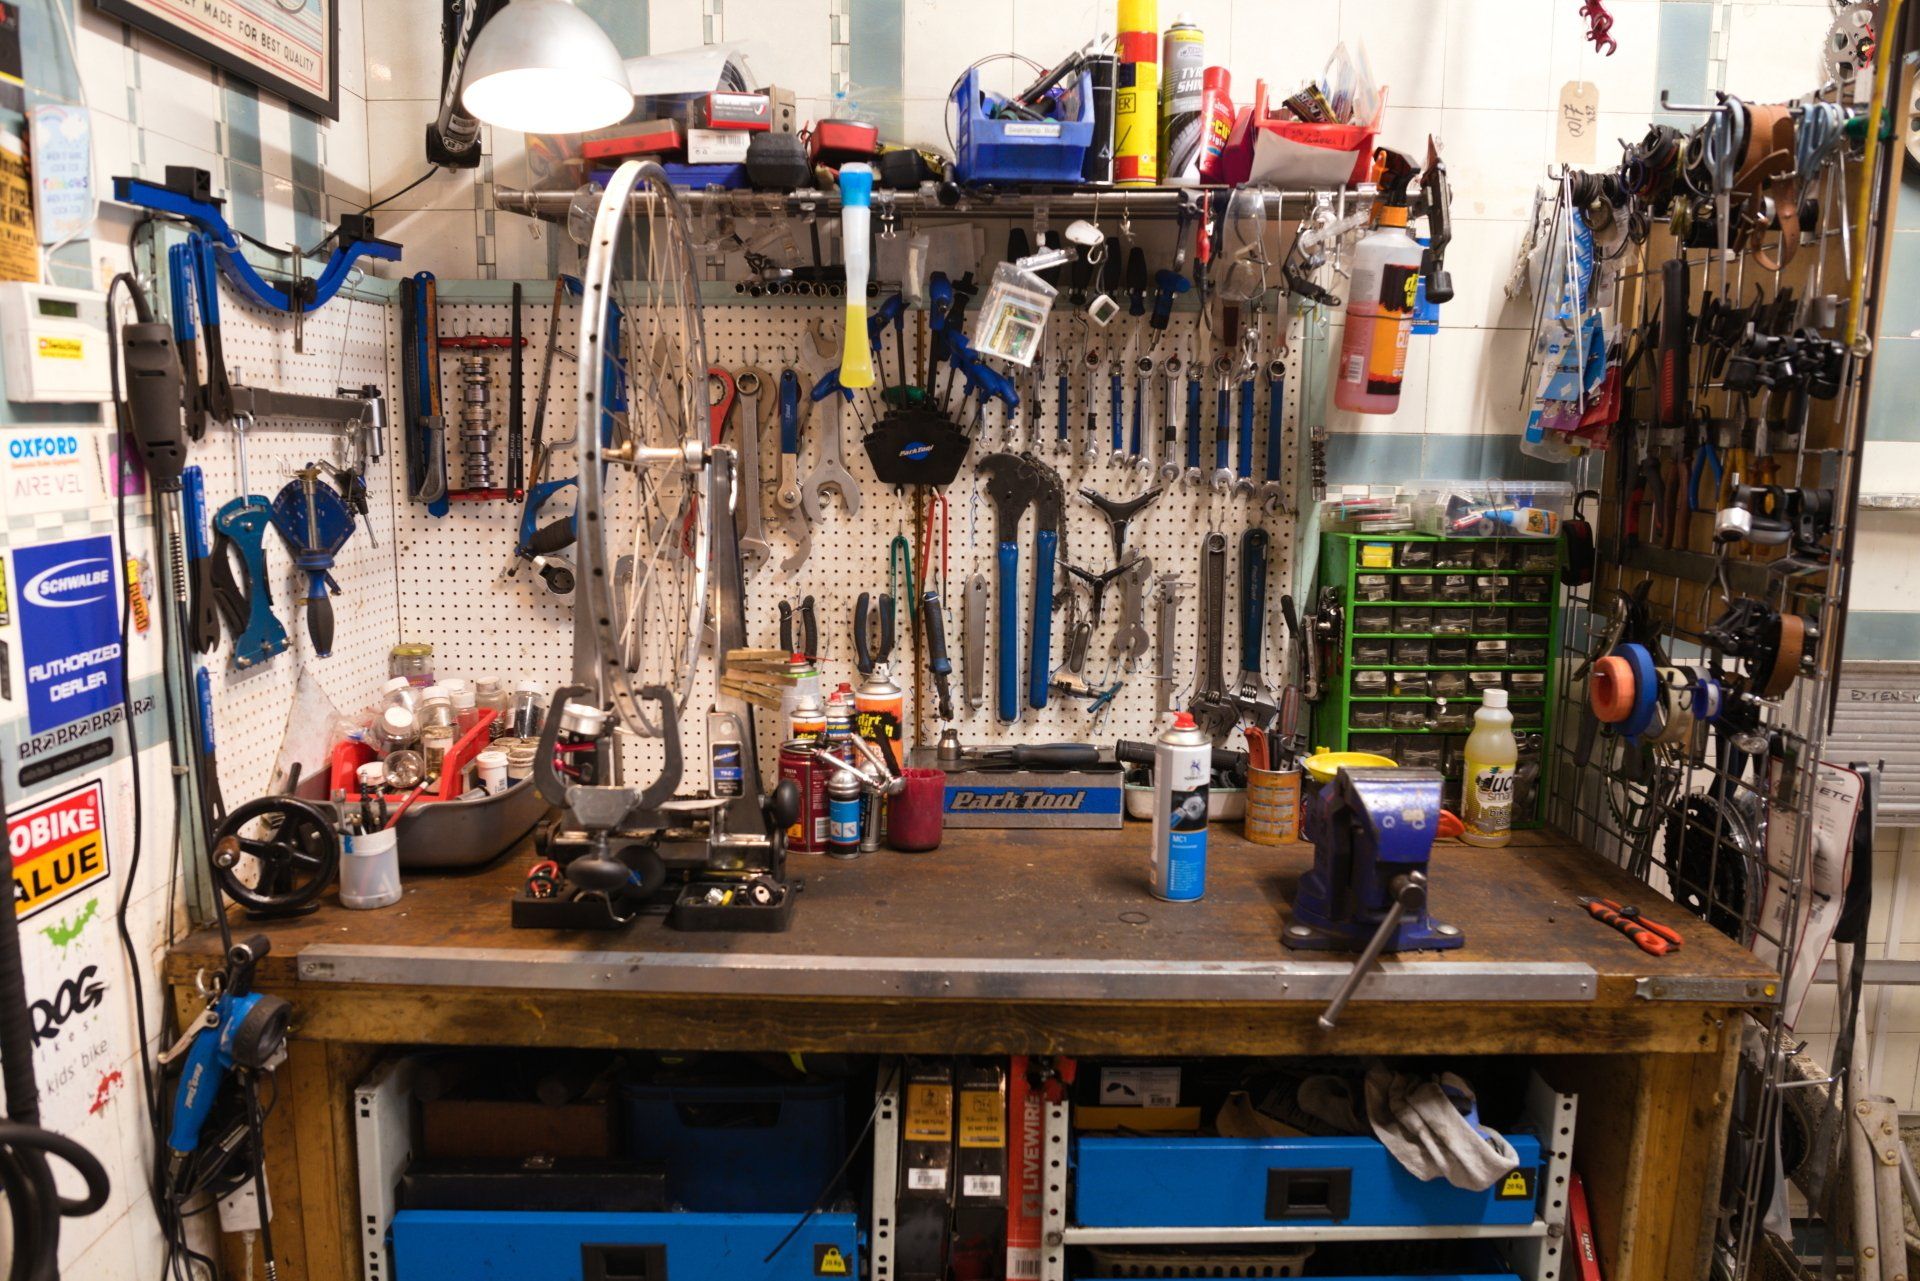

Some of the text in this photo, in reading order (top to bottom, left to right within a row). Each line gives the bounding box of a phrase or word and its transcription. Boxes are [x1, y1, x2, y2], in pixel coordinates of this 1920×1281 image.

[203, 2, 315, 72] MADE FOR BEST QUALITY
[1181, 67, 1203, 80] TYR
[1564, 104, 1585, 138] £100
[10, 436, 77, 458] OXFORD
[39, 569, 110, 596] SCHWALBE
[28, 642, 122, 684] AUTHORIZED
[50, 670, 108, 703] DEALER
[858, 713, 883, 728] dirt
[951, 790, 1086, 810] Park Tool
[9, 808, 97, 858] OBIKE
[13, 842, 99, 903] ALUE
[28, 965, 108, 1048] ROG
[41, 1020, 90, 1063] ikes
[1023, 1093, 1041, 1191] LIVEWIRE
